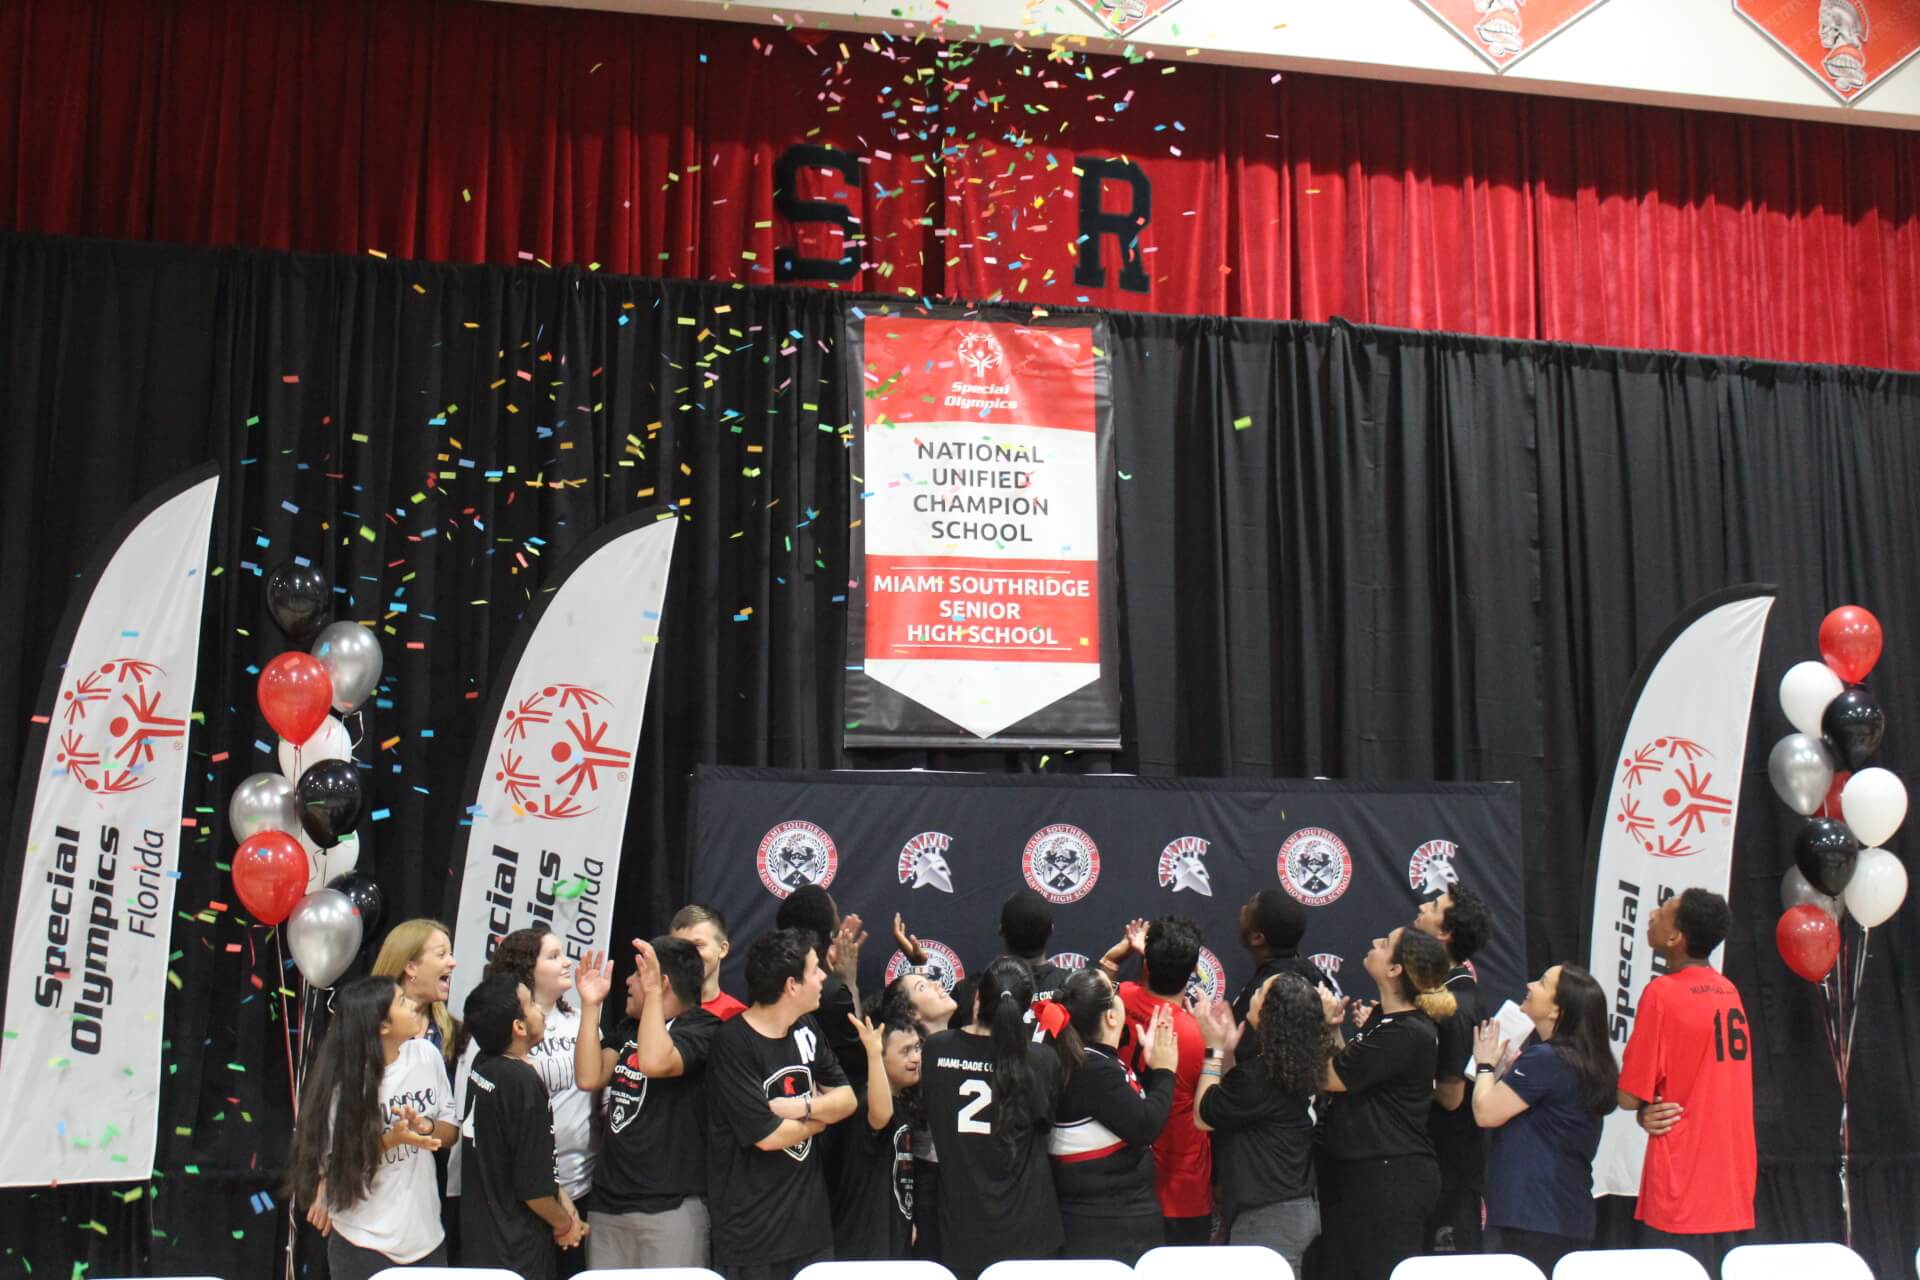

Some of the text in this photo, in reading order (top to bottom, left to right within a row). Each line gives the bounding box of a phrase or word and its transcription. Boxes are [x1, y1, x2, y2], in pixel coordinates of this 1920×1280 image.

[774, 144, 1151, 293] S R
[951, 381, 1010, 395] Special
[944, 395, 1017, 409] Olympics
[917, 440, 1044, 463] NATIONAL
[932, 468, 1030, 489] UNIFIED
[913, 494, 1048, 516] CHAMPION
[931, 520, 1033, 542] SCHOOL
[873, 575, 1090, 598] MIAMI SOUTHRIDGE
[939, 599, 1021, 620] SENIOR
[907, 624, 1058, 645] HIGH SCHOOL
[782, 822, 834, 851] SOUTHRIDGE
[128, 829, 165, 938] Florida
[566, 856, 604, 961] Florida
[1050, 894, 1073, 902] HIGH
[35, 825, 80, 1009] Special
[71, 825, 120, 1056] Olympics
[1609, 879, 1641, 1044] Special
[1713, 1007, 1748, 1062] 16
[957, 1079, 992, 1134] 2
